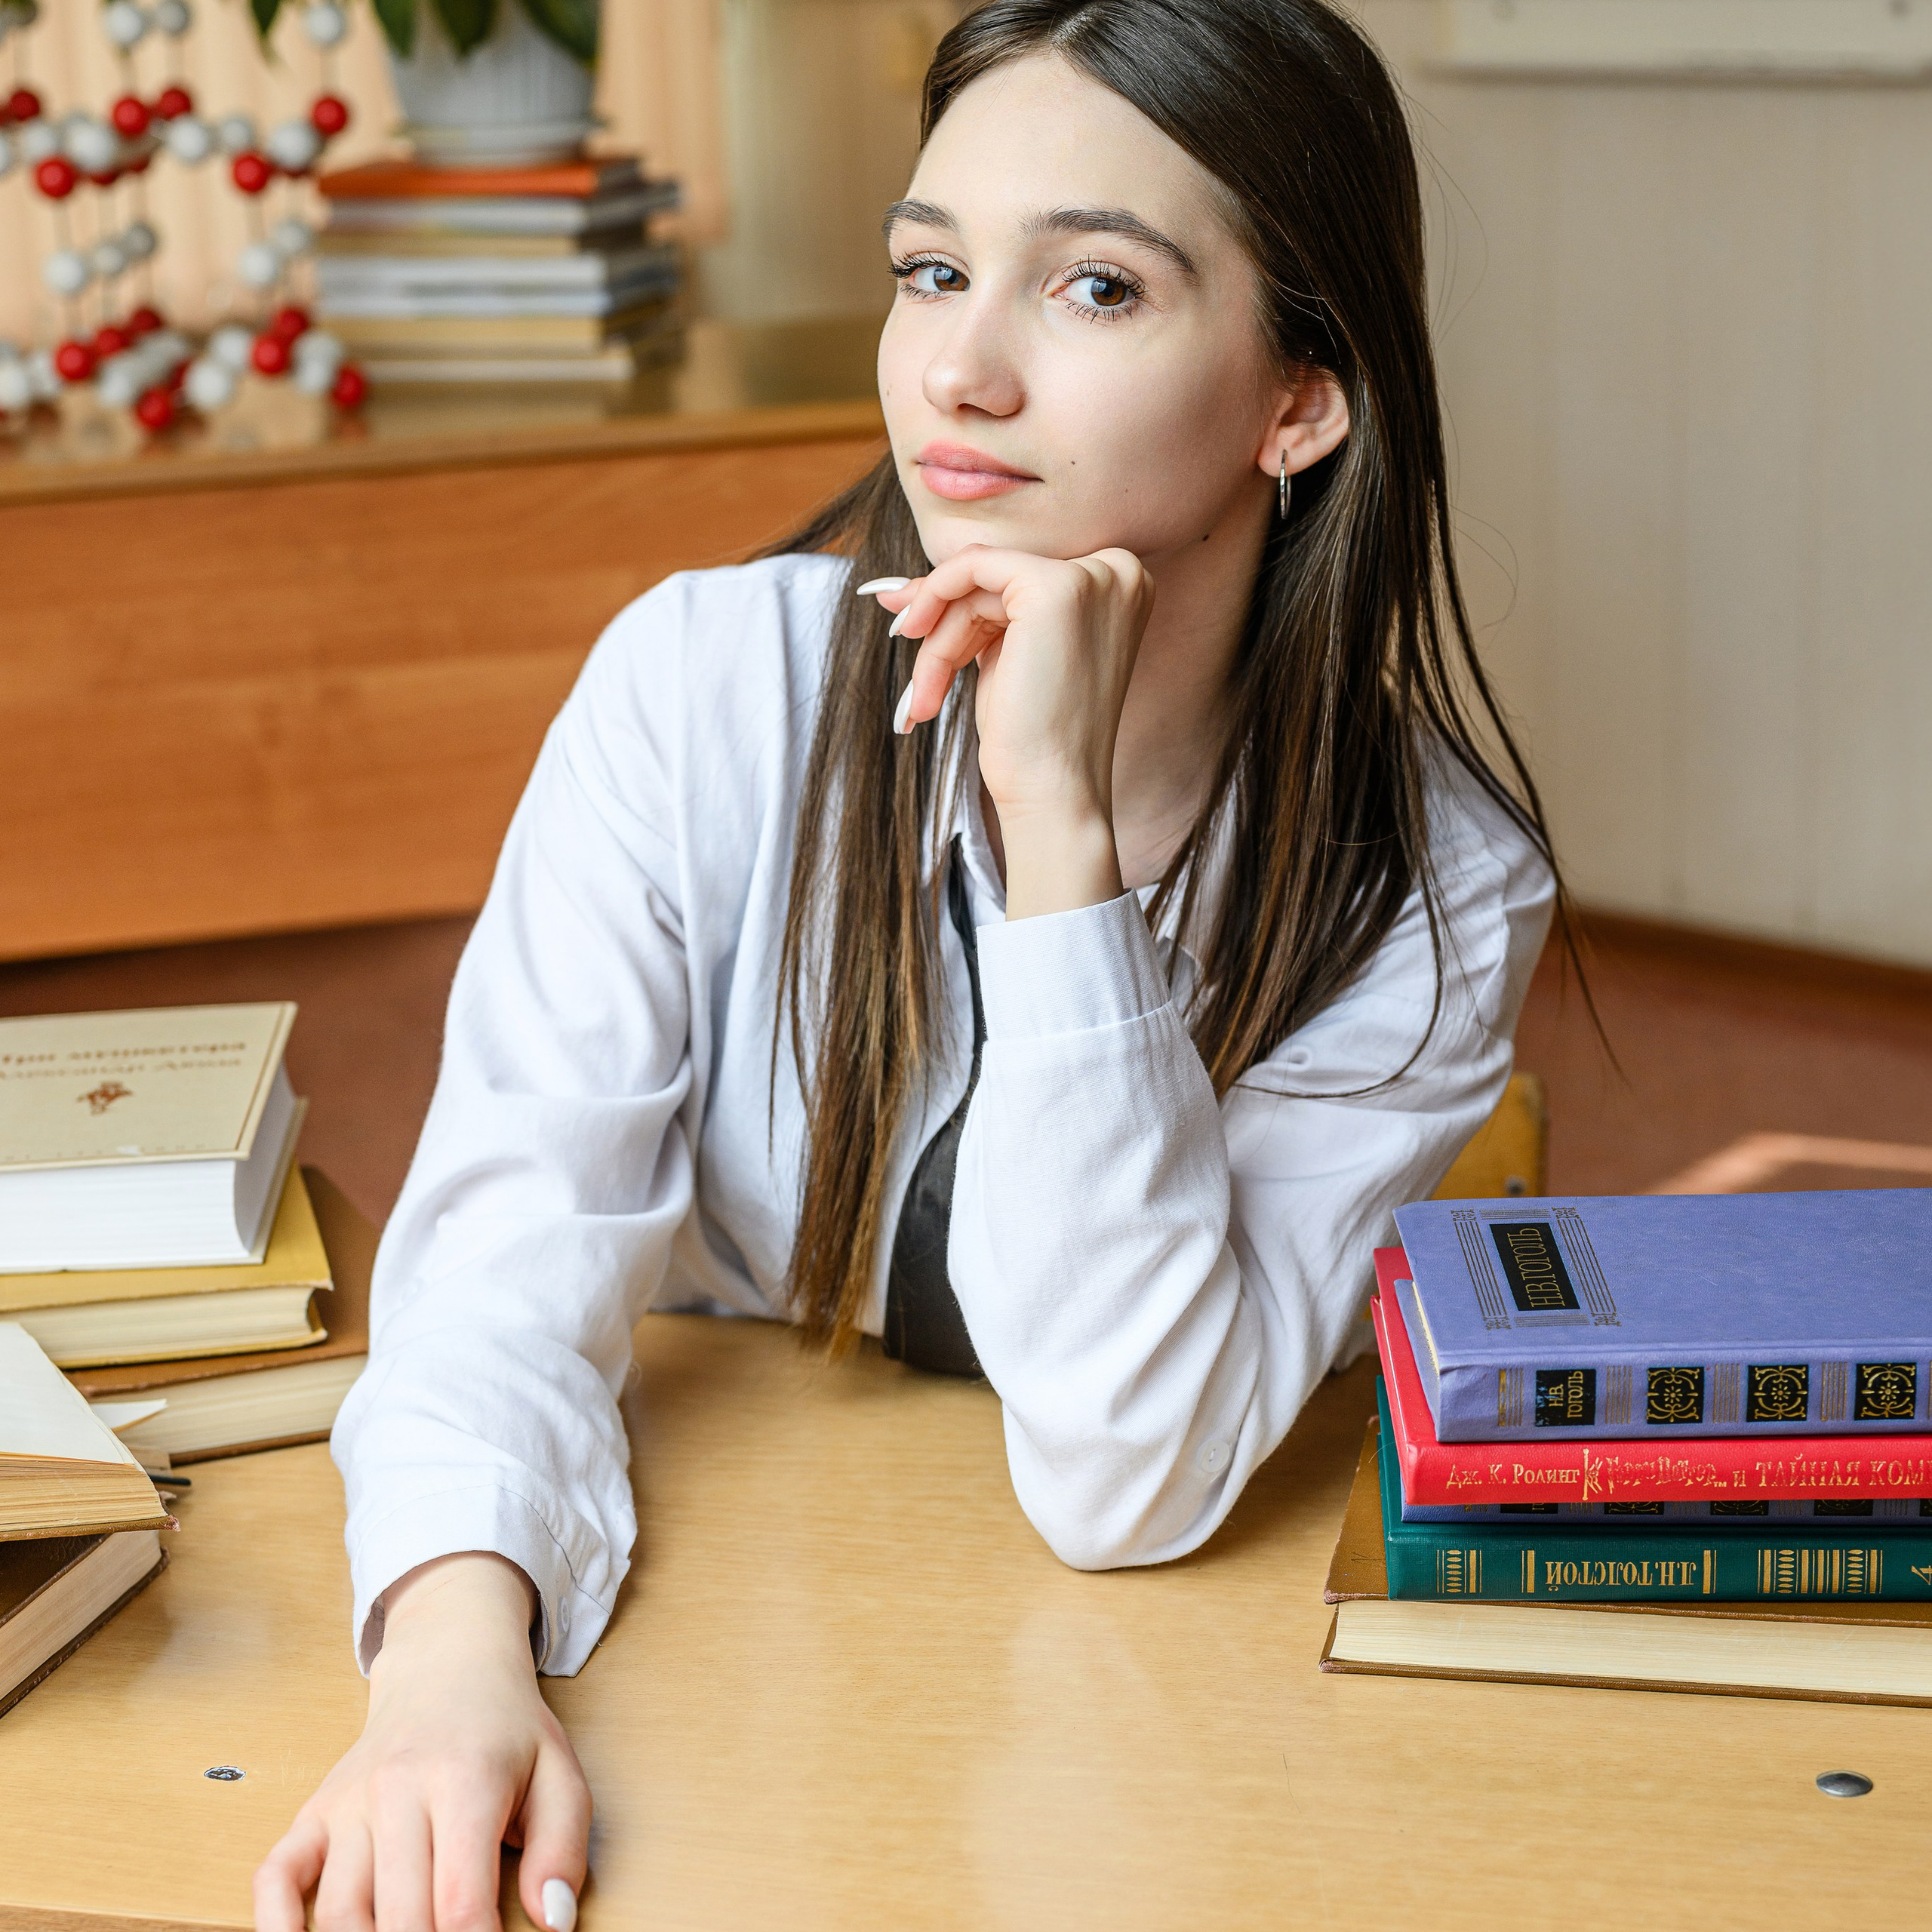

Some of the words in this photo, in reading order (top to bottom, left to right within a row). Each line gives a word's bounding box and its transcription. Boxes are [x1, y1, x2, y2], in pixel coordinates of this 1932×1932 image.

[1567, 1371, 1584, 1419] ГОГОЛЬ
[1445, 1464, 1482, 1490] Дж.
[1487, 1463, 1507, 1484] К.
[1512, 1463, 1580, 1484] Ролинг
[1755, 1453, 1861, 1487] ТАЙНАЯ
